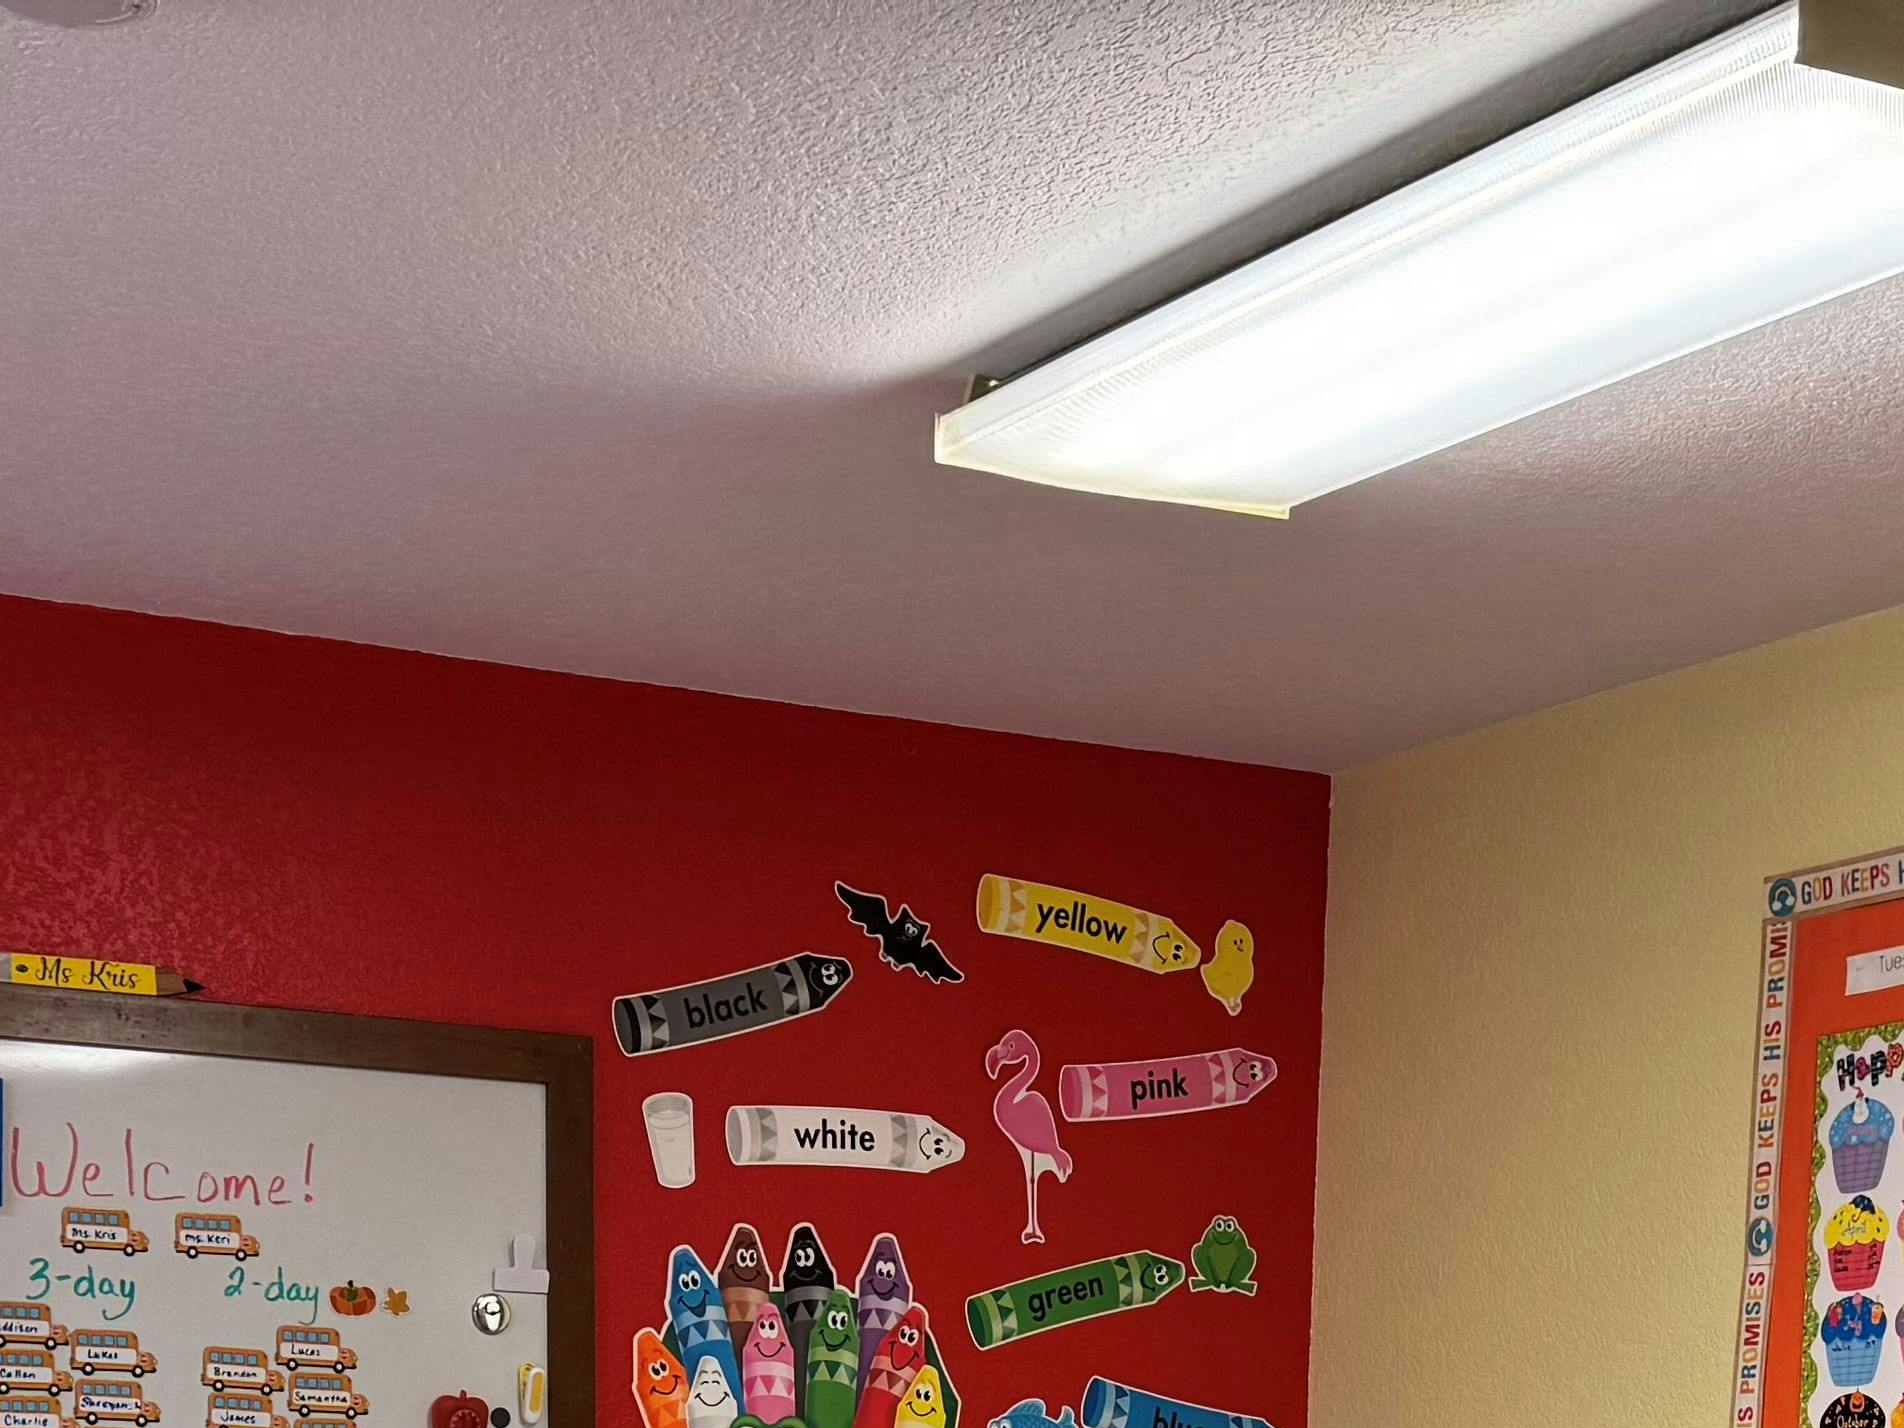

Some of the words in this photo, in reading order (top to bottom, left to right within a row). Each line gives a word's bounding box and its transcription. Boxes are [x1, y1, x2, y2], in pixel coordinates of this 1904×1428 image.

[1801, 874, 1834, 906] GOD
[1840, 862, 1890, 899] KEEPS
[1035, 900, 1128, 947] yellow
[34, 956, 73, 986] Ms
[82, 958, 142, 990] Kris
[684, 982, 768, 1030] black
[1130, 1069, 1189, 1110] pink
[794, 1118, 875, 1153] white
[10, 1122, 315, 1206] Welcome!
[25, 1258, 136, 1322] 3-day
[224, 1266, 320, 1326] 2-day
[1027, 1274, 1105, 1322] green
[4, 1413, 49, 1427] Charlie
